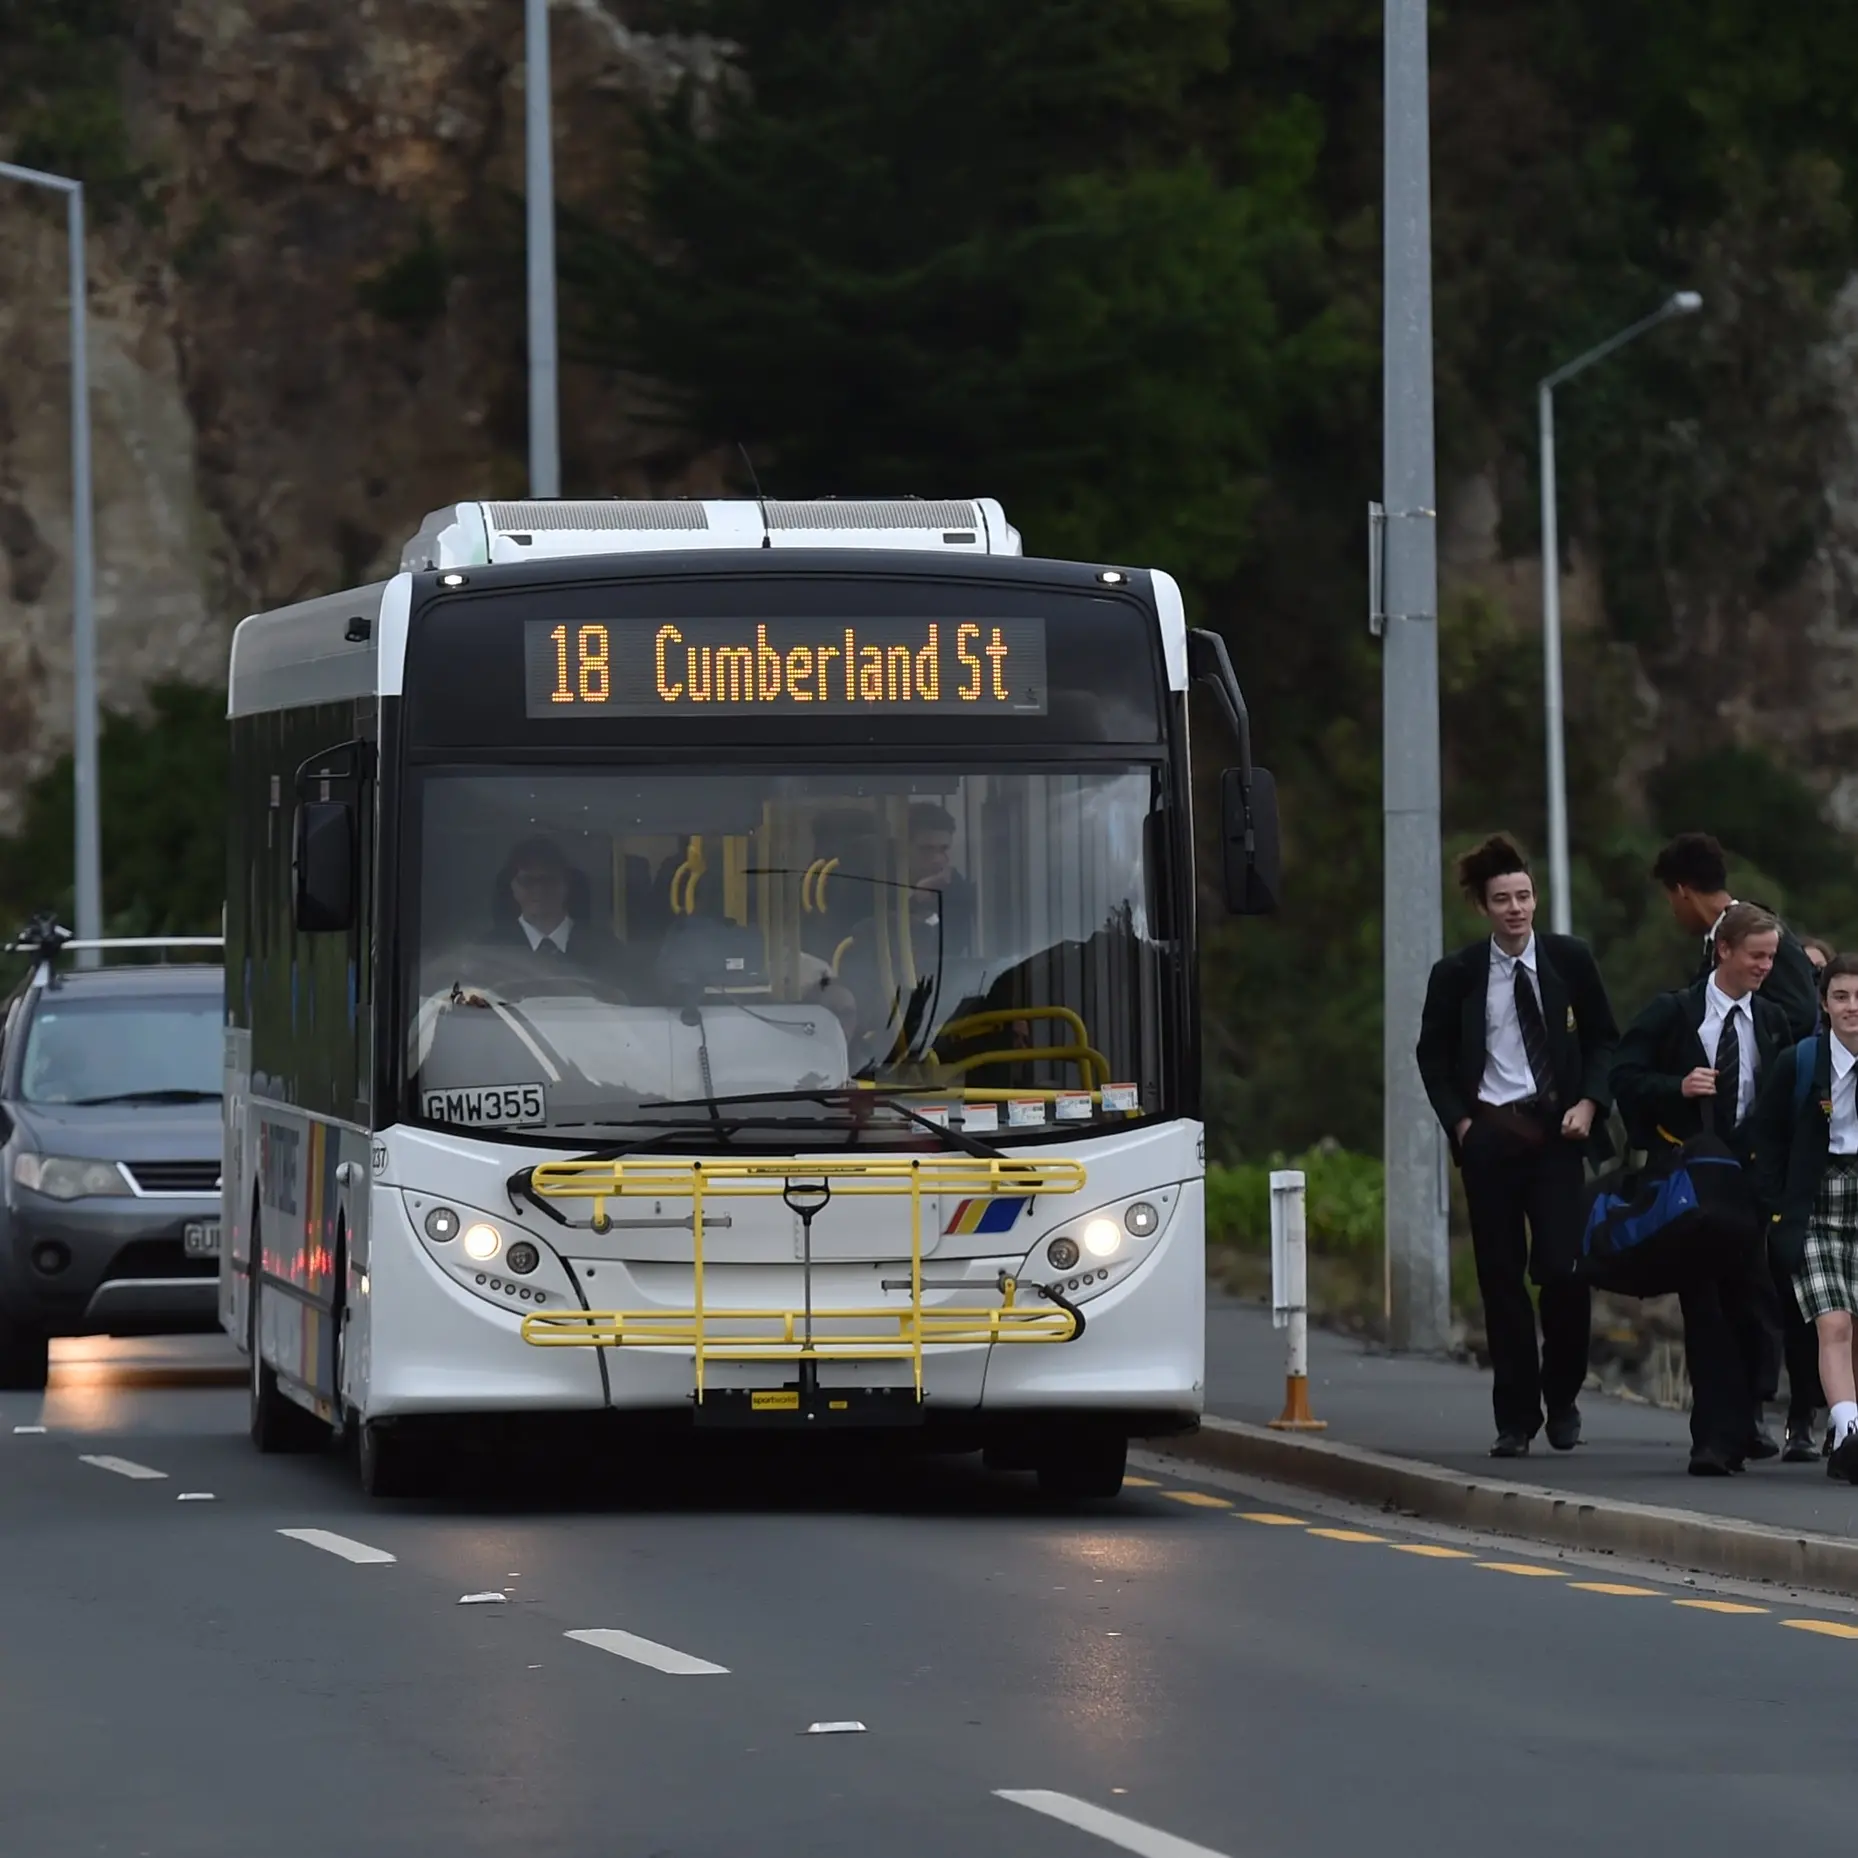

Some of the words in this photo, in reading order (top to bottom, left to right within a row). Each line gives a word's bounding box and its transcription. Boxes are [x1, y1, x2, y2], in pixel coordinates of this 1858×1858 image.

[551, 624, 610, 703] 18
[655, 623, 940, 702] Cumberland
[956, 623, 1009, 701] St
[427, 1089, 541, 1122] GMW355
[187, 1228, 221, 1250] GU
